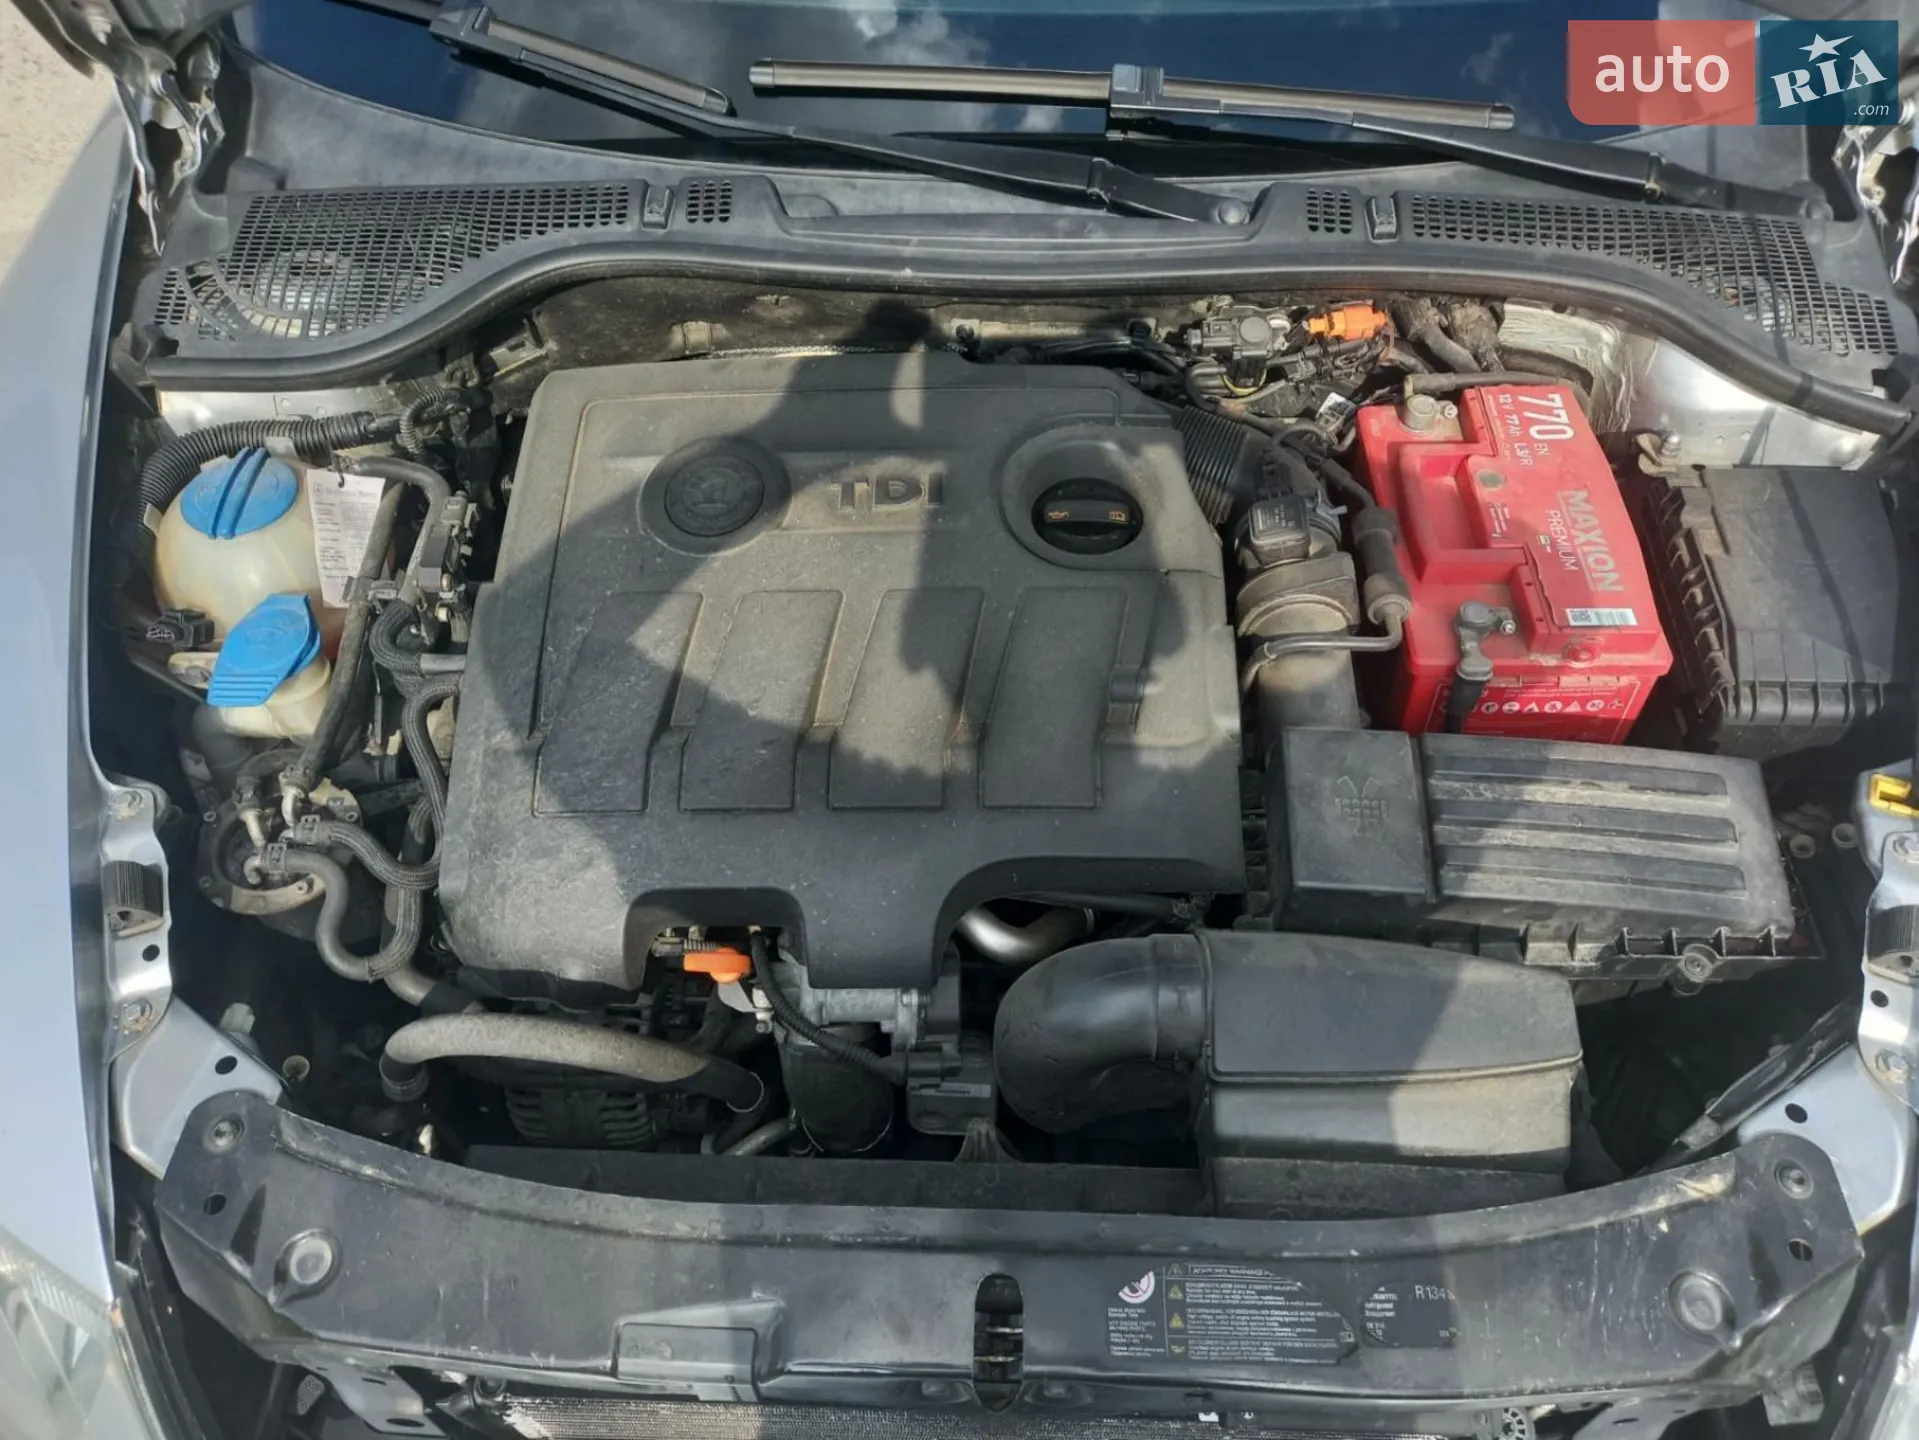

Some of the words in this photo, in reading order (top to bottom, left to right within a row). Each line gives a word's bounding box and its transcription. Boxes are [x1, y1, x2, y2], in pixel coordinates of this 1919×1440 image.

[1517, 393, 1574, 440] 770
[827, 472, 944, 511] TDI
[1545, 509, 1580, 571] PREMIUM
[1563, 490, 1625, 592] MAXION
